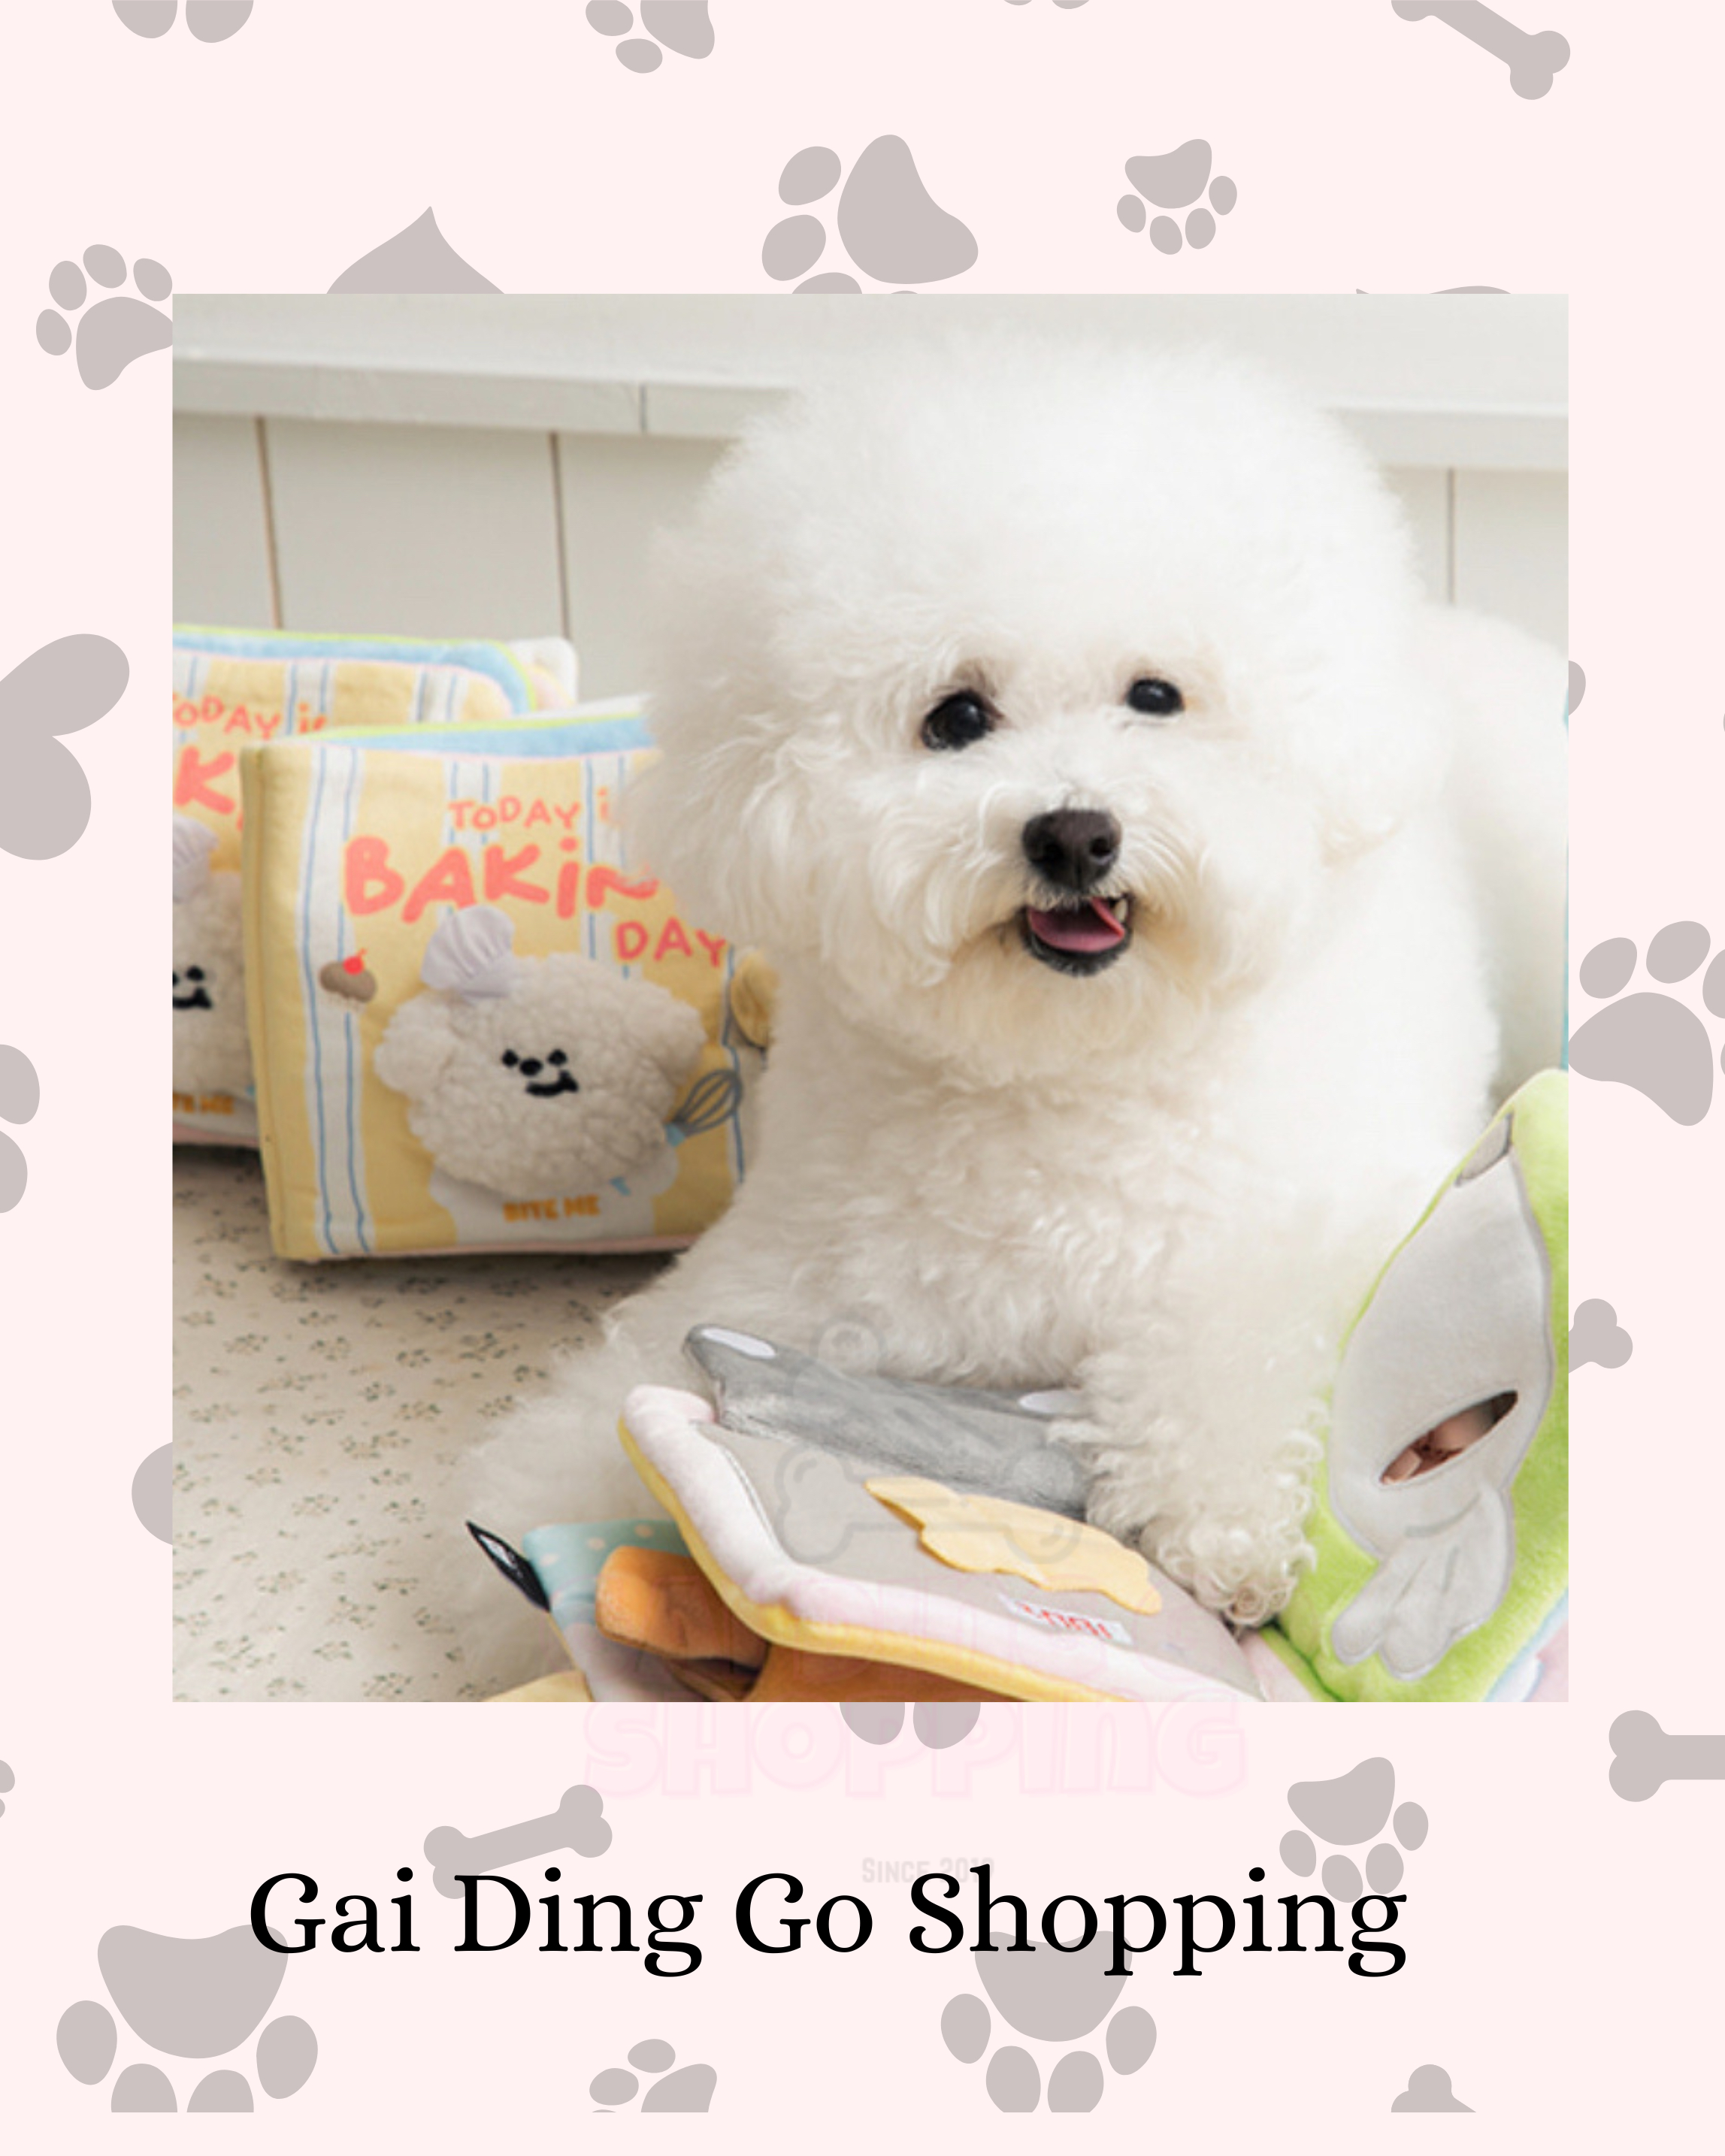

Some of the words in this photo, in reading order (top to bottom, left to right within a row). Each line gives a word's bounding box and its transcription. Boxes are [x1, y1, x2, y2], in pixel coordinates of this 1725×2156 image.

[173, 692, 281, 740] ODAY
[449, 796, 581, 832] TODAY
[615, 917, 727, 968] DAY
[503, 1197, 559, 1223] BITE
[563, 1193, 601, 1220] ME
